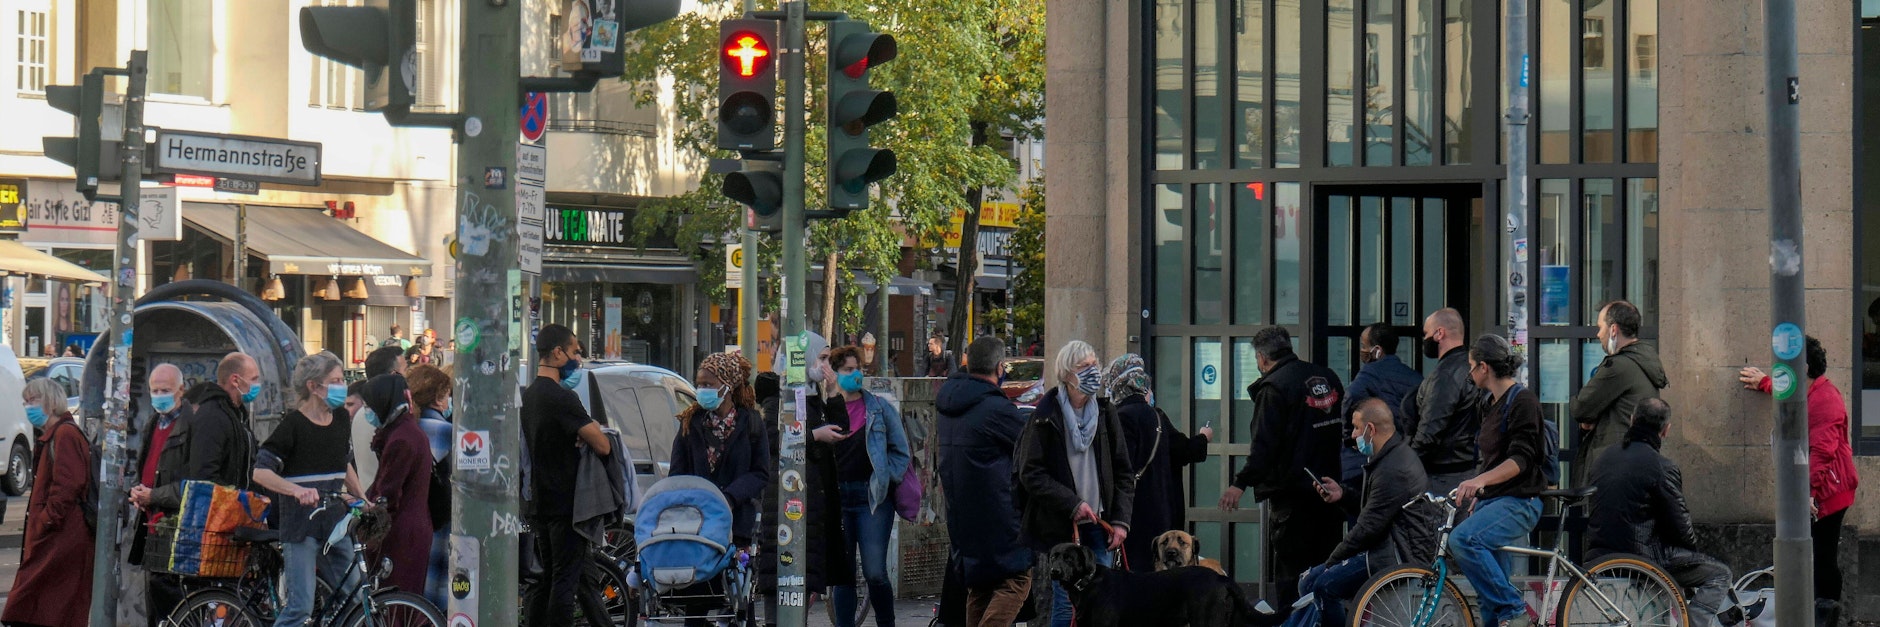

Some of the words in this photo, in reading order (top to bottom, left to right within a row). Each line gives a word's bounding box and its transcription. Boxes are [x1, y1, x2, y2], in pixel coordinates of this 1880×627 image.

[168, 138, 307, 174] Hermannstraße
[545, 208, 624, 243] ULTEAMATE
[1312, 384, 1329, 396] CSE
[778, 590, 804, 607] FACH
